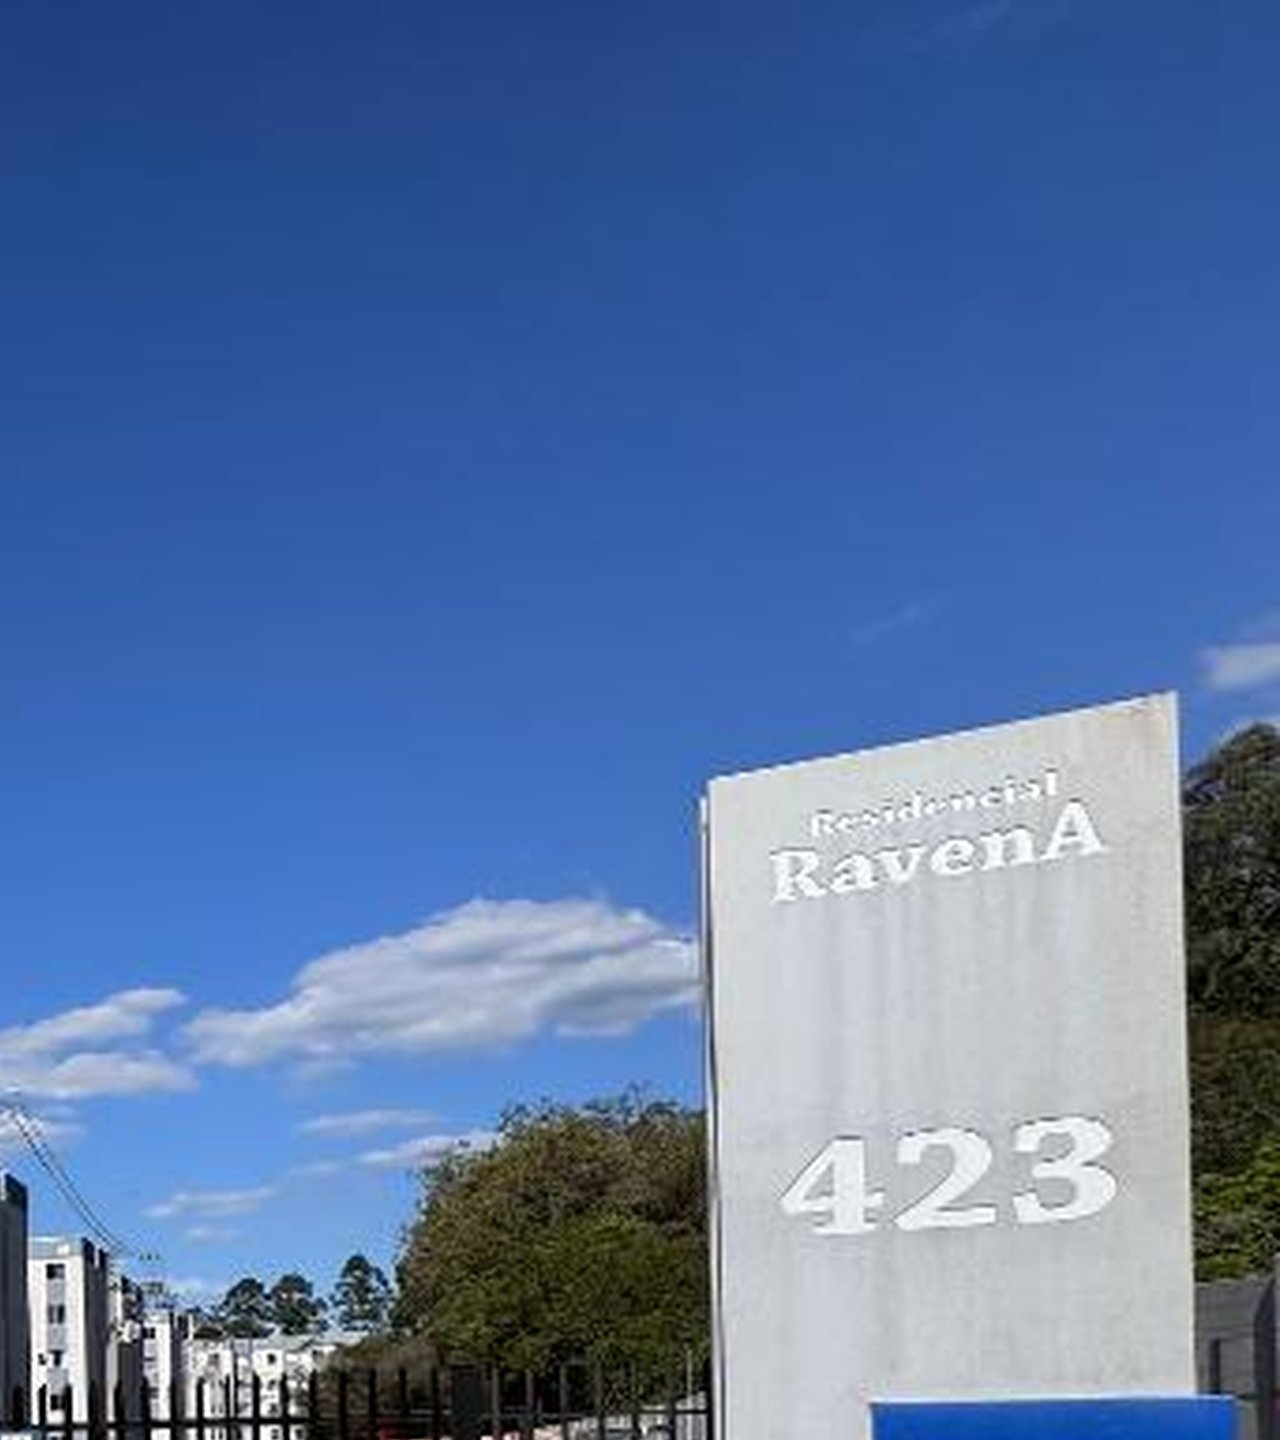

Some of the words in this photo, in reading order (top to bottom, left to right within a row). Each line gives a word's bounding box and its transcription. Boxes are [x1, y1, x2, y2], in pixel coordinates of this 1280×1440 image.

[769, 798, 1110, 902] RavenA
[809, 769, 1059, 838] Residencial
[780, 1114, 1118, 1236] 423
